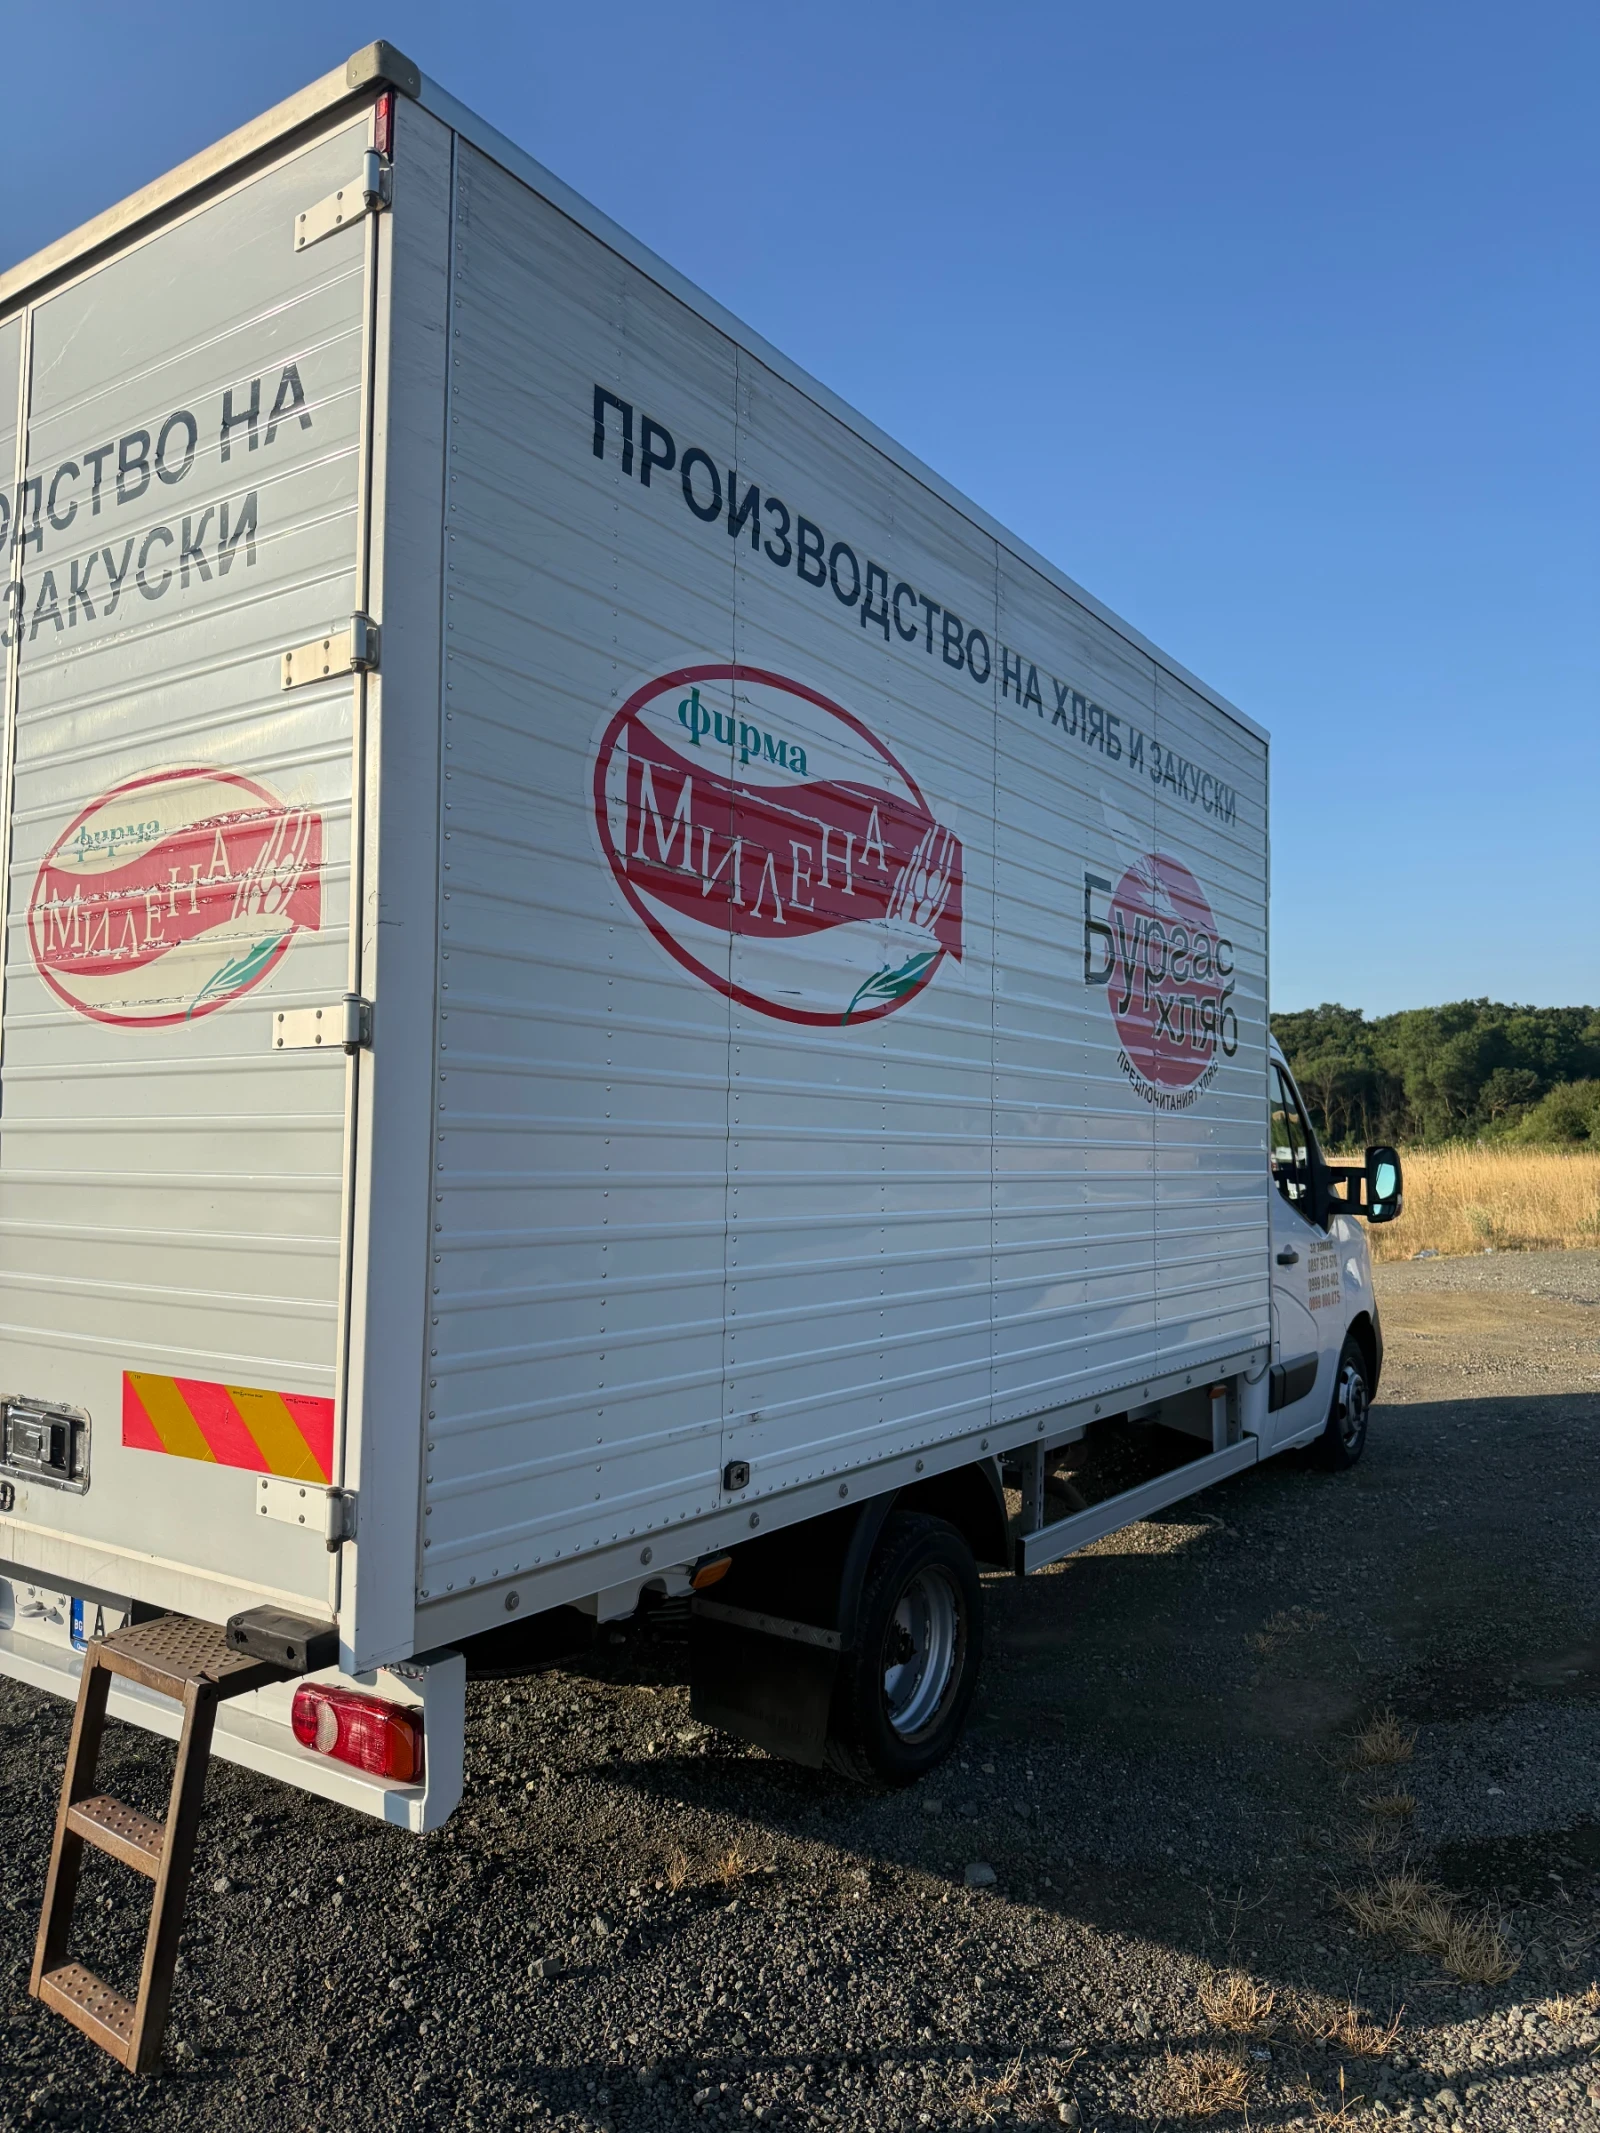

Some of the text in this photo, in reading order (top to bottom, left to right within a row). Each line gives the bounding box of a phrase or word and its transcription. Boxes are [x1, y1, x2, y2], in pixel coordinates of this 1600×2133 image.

[220, 361, 313, 464] НА
[0, 490, 258, 648] ЗАКУСКИ
[592, 383, 1237, 828] ПРОИЗВОДСТВО НА ХЛЯБ И ЗАКУСКИ
[677, 686, 810, 777] фирма
[1084, 871, 1235, 1016] Бургас
[74, 1618, 84, 1632] BG
